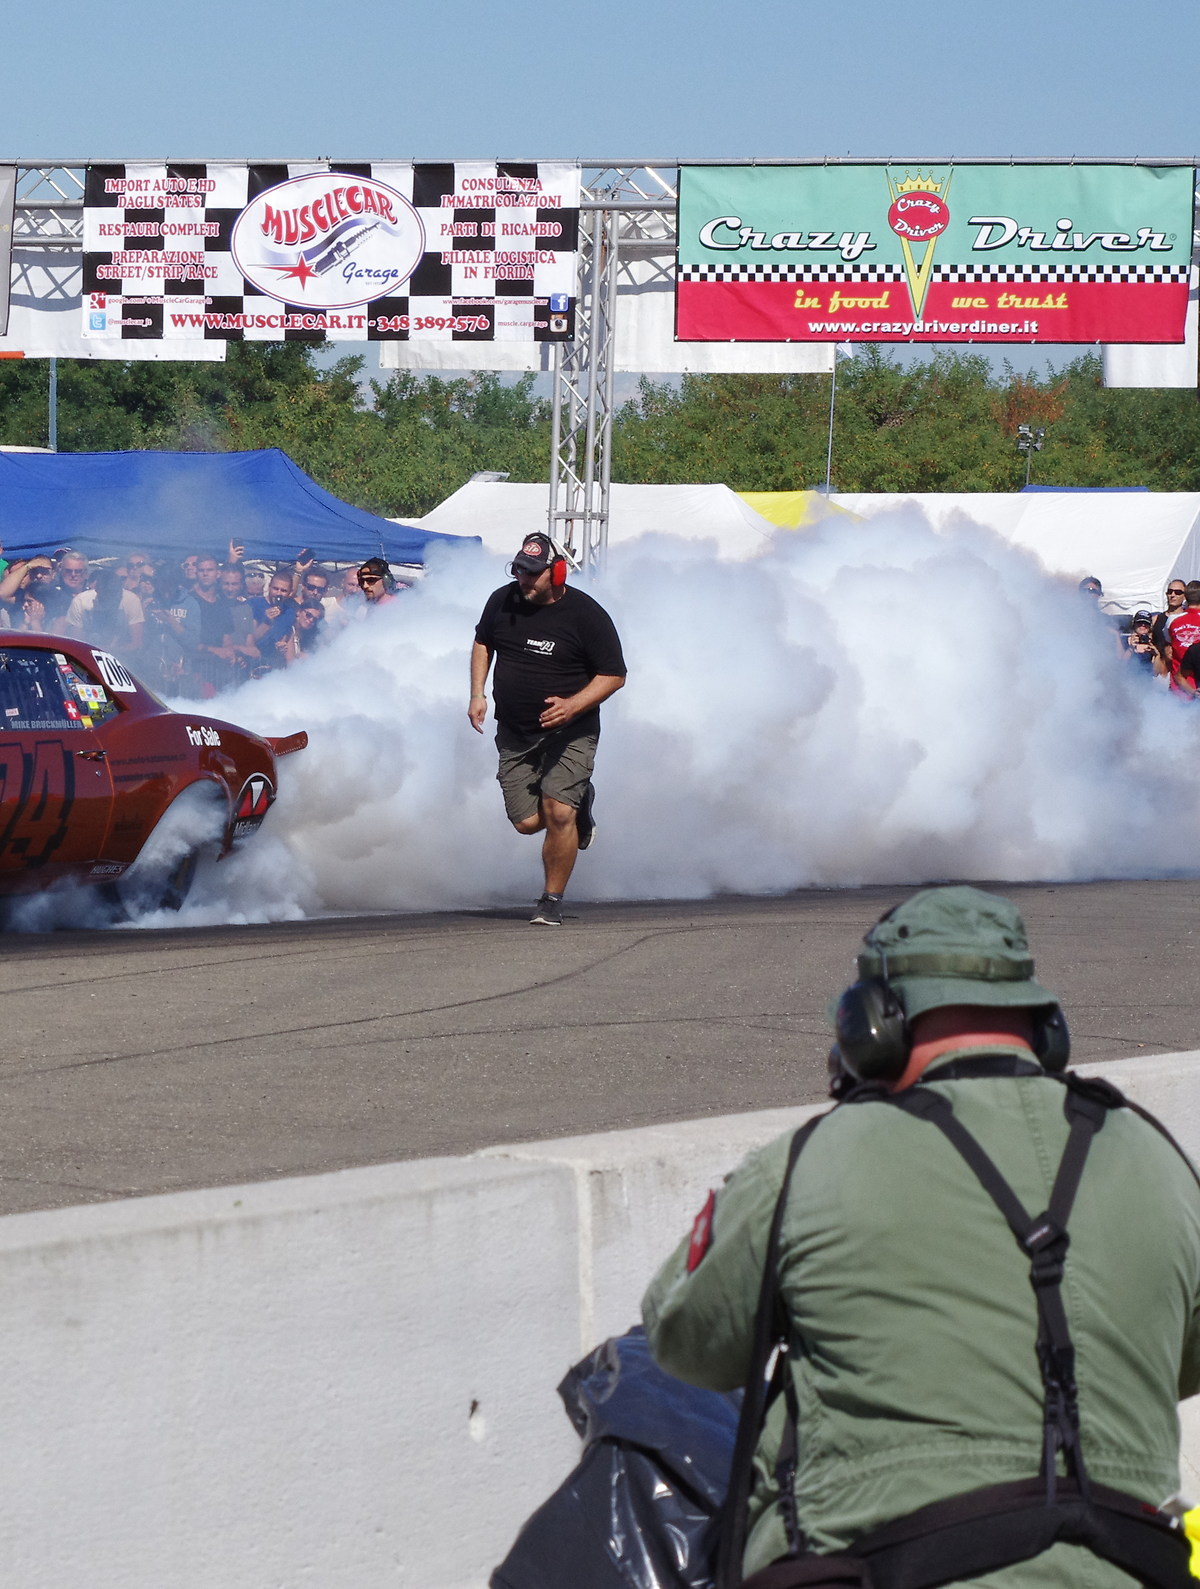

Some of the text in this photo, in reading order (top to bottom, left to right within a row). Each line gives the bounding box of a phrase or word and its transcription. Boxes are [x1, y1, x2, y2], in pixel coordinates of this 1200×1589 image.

[105, 179, 216, 192] IMPORT AUTO E HD
[461, 178, 543, 191] CONSULENZA
[118, 195, 201, 208] DAGLI STATES
[441, 195, 562, 208] IMMATRICOLAZIONI
[896, 198, 941, 214] Crazy
[260, 185, 398, 246] MUSCLECAR
[98, 223, 219, 236] RESTAURI COMPLETI
[440, 223, 561, 236] PARTI DI RICAMBIO
[893, 218, 945, 237] Driver
[968, 215, 1174, 252] Driver
[699, 215, 877, 262] Crazy
[112, 251, 205, 263] PREPARAZIONE
[441, 251, 557, 264] FILIALE LOGISTICA
[96, 266, 218, 281] STREET/STRIP/RACE
[342, 261, 399, 285] Garage
[463, 266, 535, 279] IN FLORIDA
[793, 289, 890, 313] in food
[952, 290, 1070, 309] we trust
[170, 313, 367, 330] WWW.MUSCLECAR.IT
[377, 315, 411, 331] 348
[413, 314, 490, 332] 3892576
[808, 318, 1039, 336] www.crazydriverdiner.it
[93, 655, 132, 687] 706
[11, 718, 83, 730] MIKE BRUCKMÜLLER
[186, 725, 221, 747] For Sale
